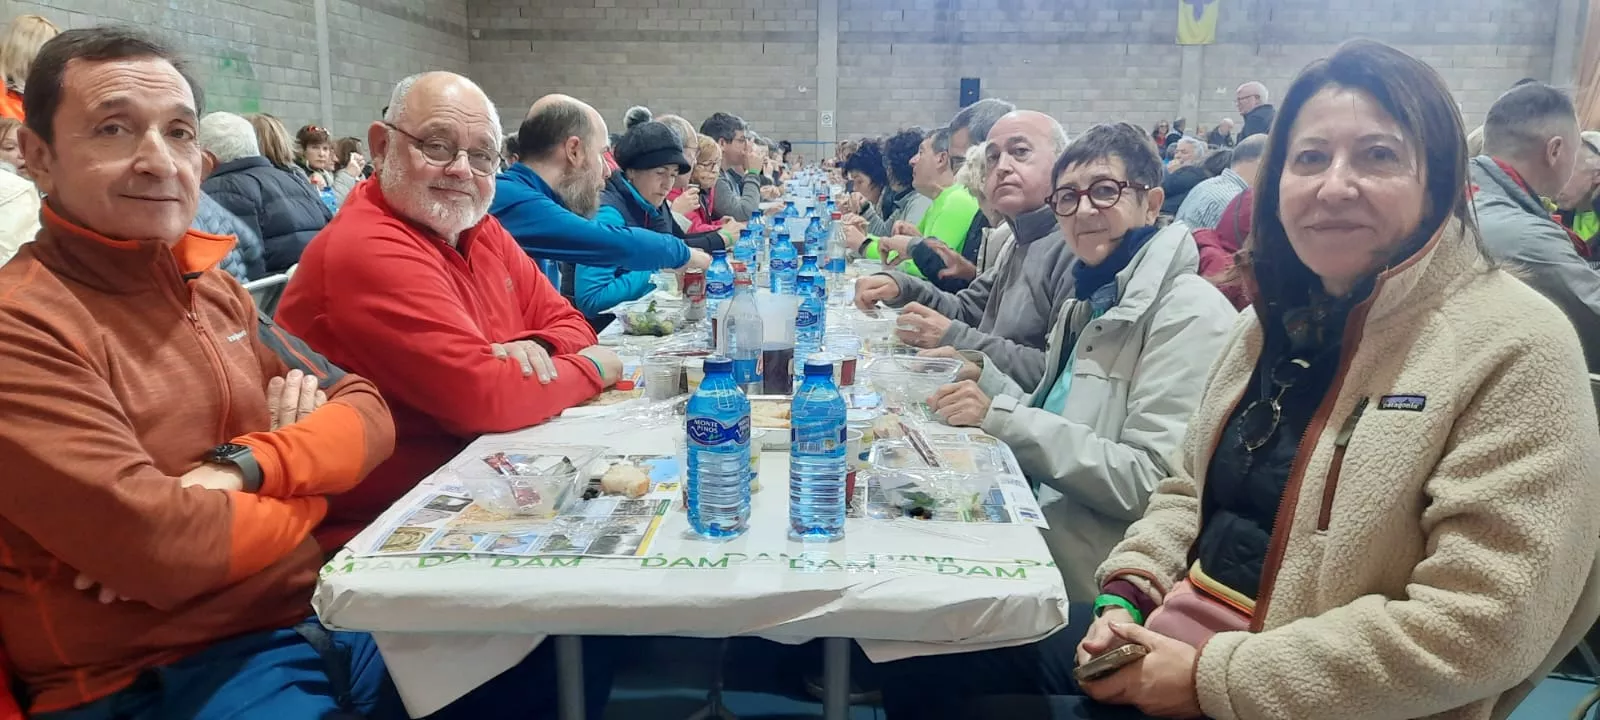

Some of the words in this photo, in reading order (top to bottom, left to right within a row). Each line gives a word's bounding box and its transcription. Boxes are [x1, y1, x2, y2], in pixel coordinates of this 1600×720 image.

[694, 419, 718, 427] MONTE
[696, 425, 718, 434] PINOS
[491, 555, 582, 569] DAM
[640, 556, 730, 568] DAM
[937, 563, 1027, 579] DAM
